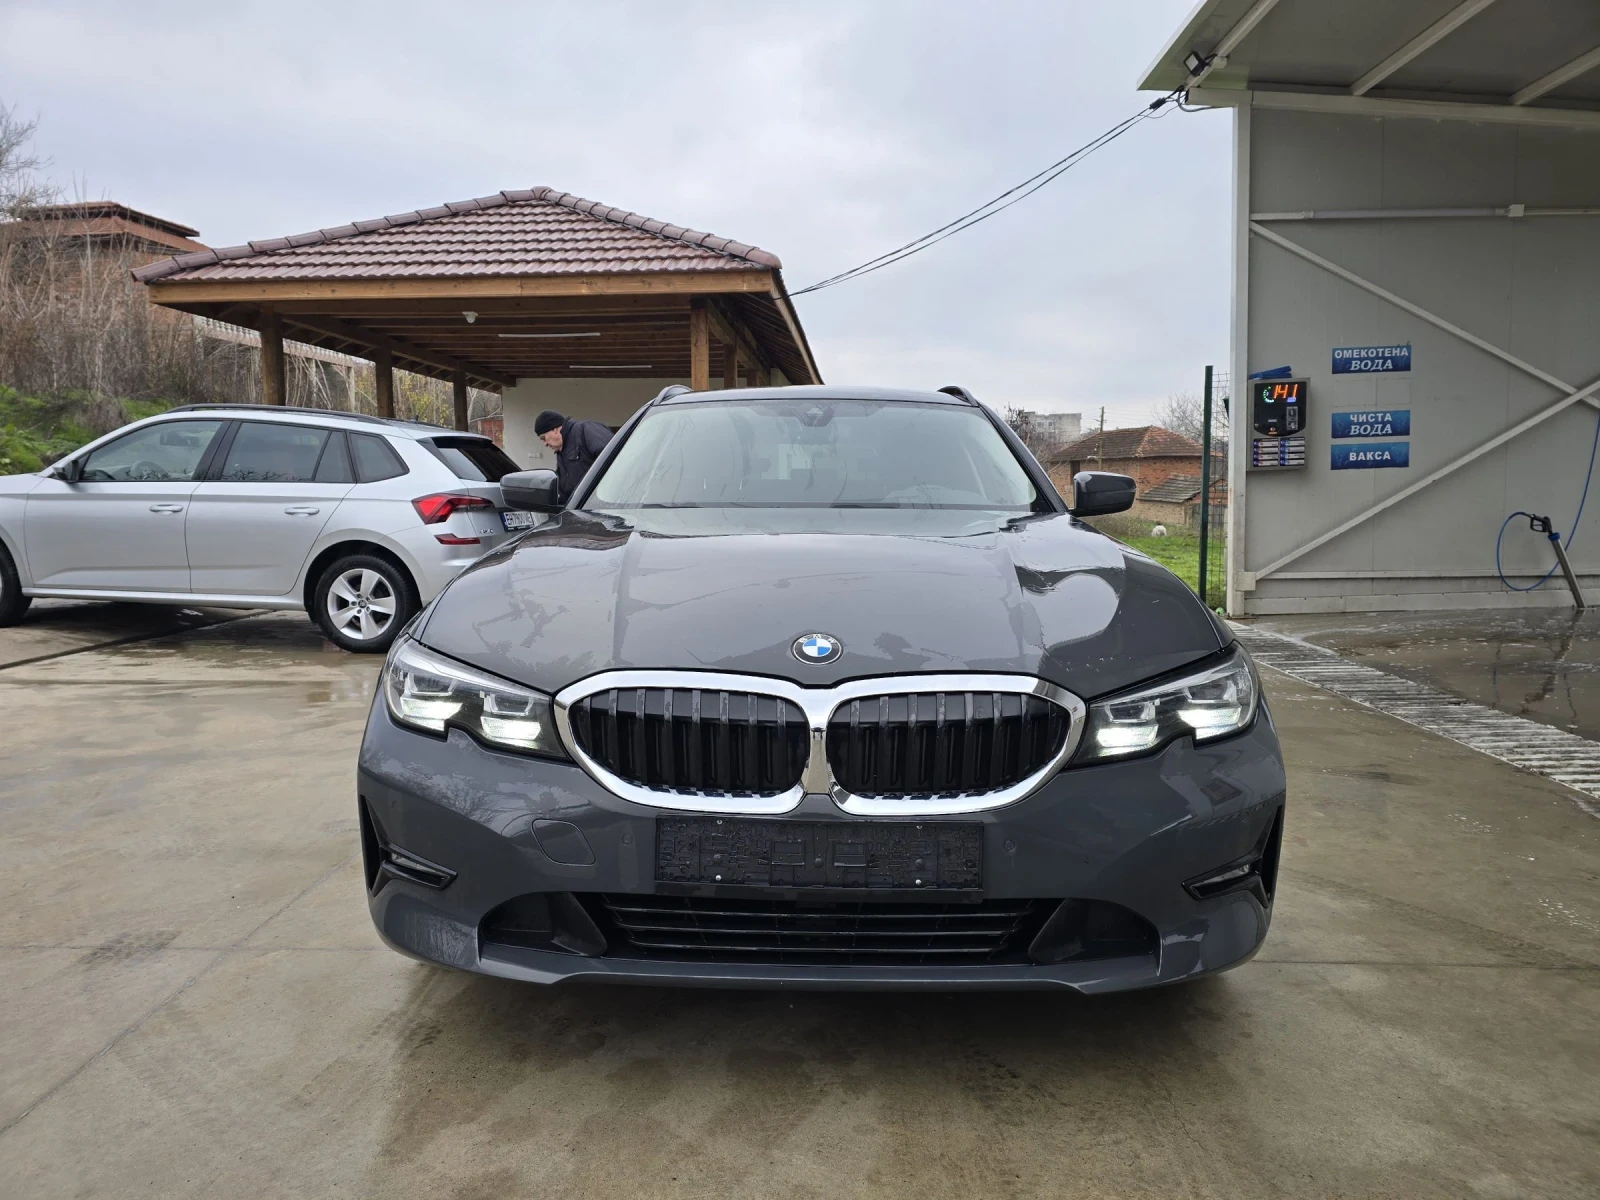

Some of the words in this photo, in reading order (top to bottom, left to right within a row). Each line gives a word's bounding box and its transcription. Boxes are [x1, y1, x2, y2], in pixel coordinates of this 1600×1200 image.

[1334, 347, 1409, 359] ОМЕКОТЕНА
[1350, 359, 1393, 371] ВОДА
[1349, 413, 1392, 423] ЧИСТА
[1349, 424, 1393, 436] ВОДА
[1349, 451, 1391, 461] ВАКСА
